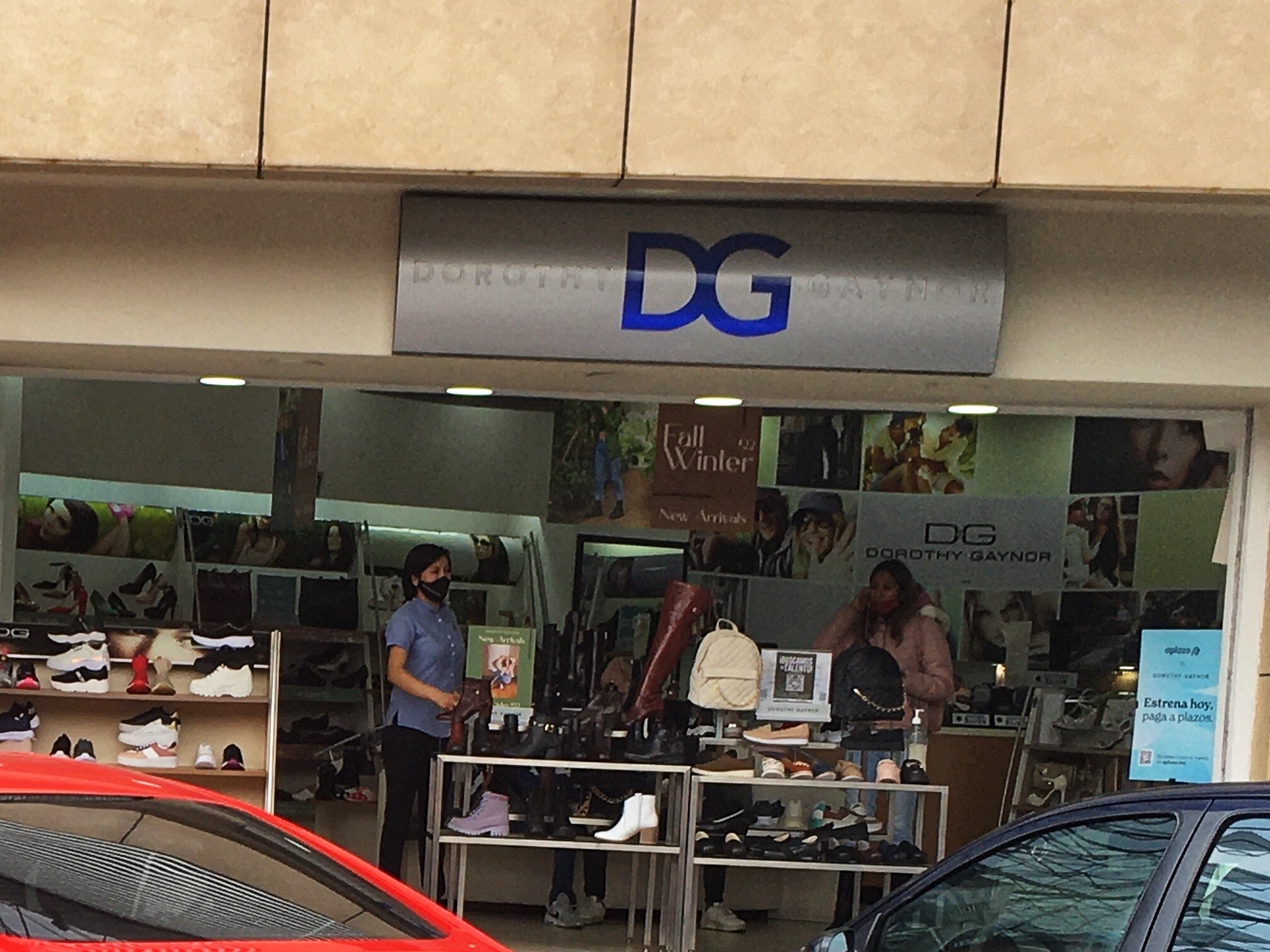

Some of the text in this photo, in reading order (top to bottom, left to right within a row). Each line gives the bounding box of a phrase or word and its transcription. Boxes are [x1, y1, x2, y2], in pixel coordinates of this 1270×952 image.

[412, 260, 613, 292] DOROTHY
[620, 231, 792, 338] DG
[663, 423, 704, 448] Fall
[664, 446, 754, 473] Winter
[659, 508, 747, 524] New Arrivals
[924, 522, 997, 546] DG
[865, 547, 1052, 563] DOROTHY GAYNOR
[1143, 697, 1214, 711] Estrena hoy,
[1142, 712, 1214, 724] paga a plazos.
